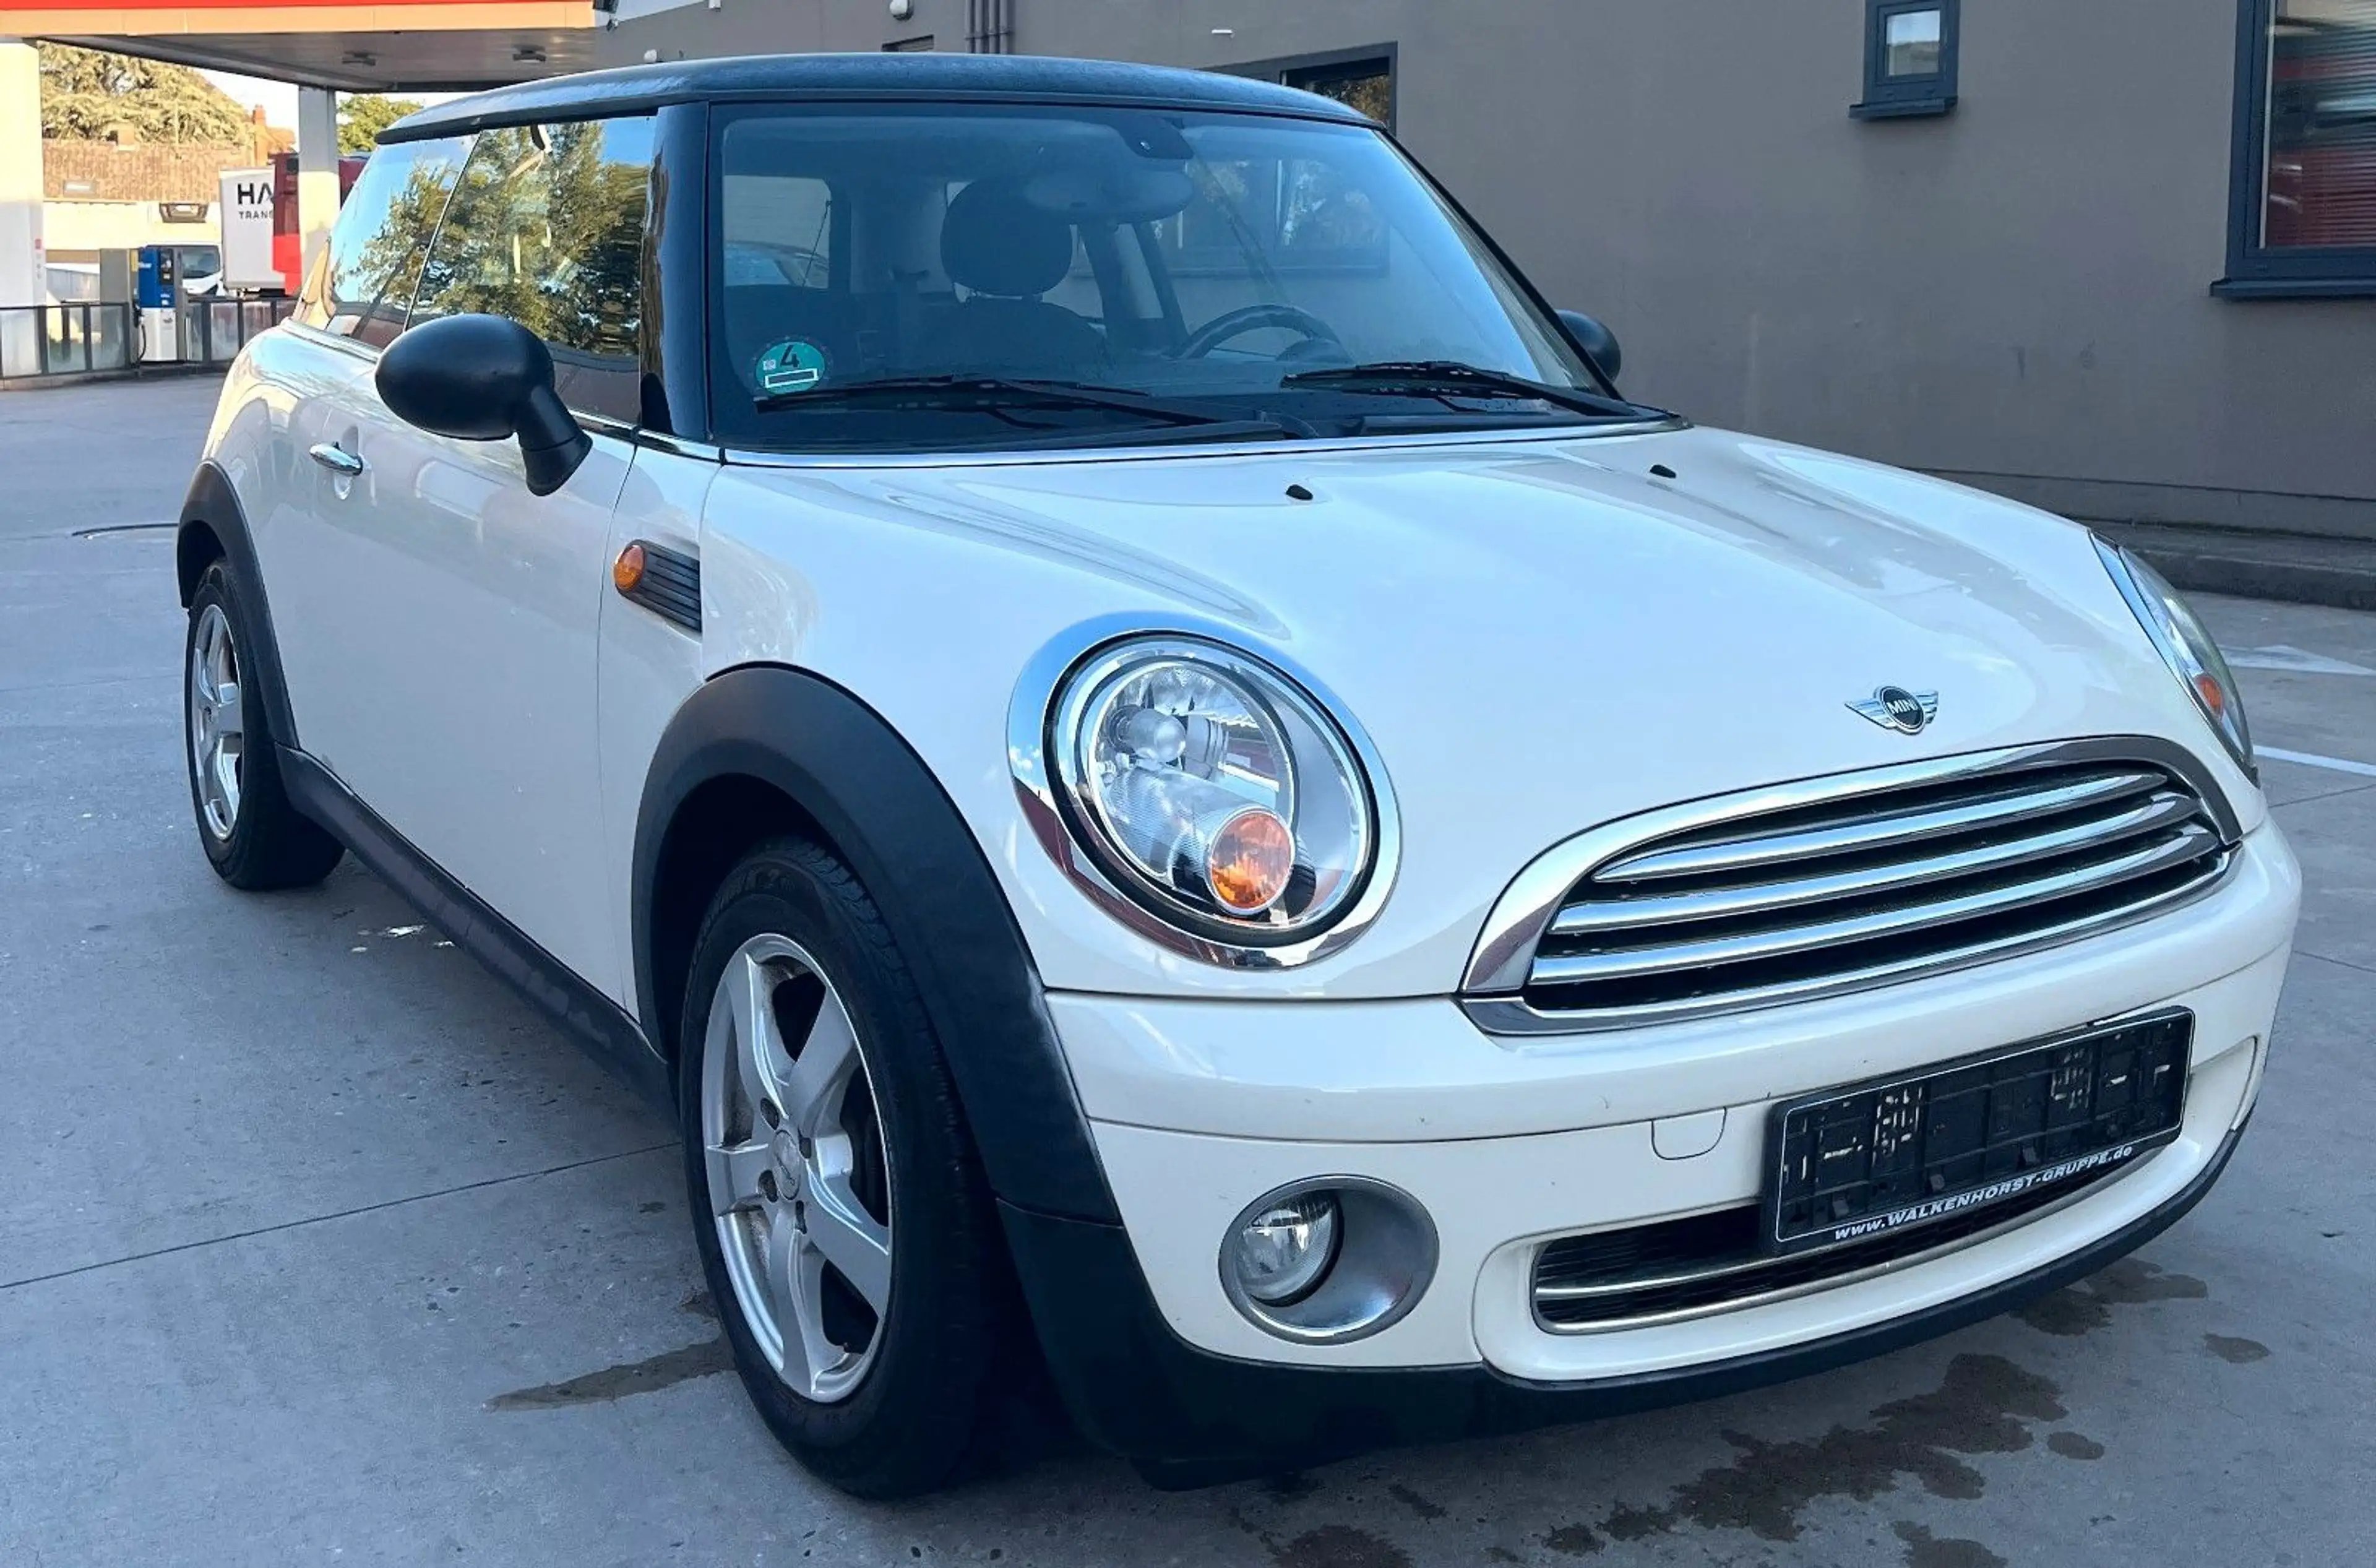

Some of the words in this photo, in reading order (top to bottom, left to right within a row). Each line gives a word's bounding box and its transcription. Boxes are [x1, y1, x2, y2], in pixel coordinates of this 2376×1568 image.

[780, 344, 800, 368] 4
[1886, 699, 1918, 714] MINI
[1834, 1145, 2133, 1240] www.WALKENHORST-GRUPPE.de
